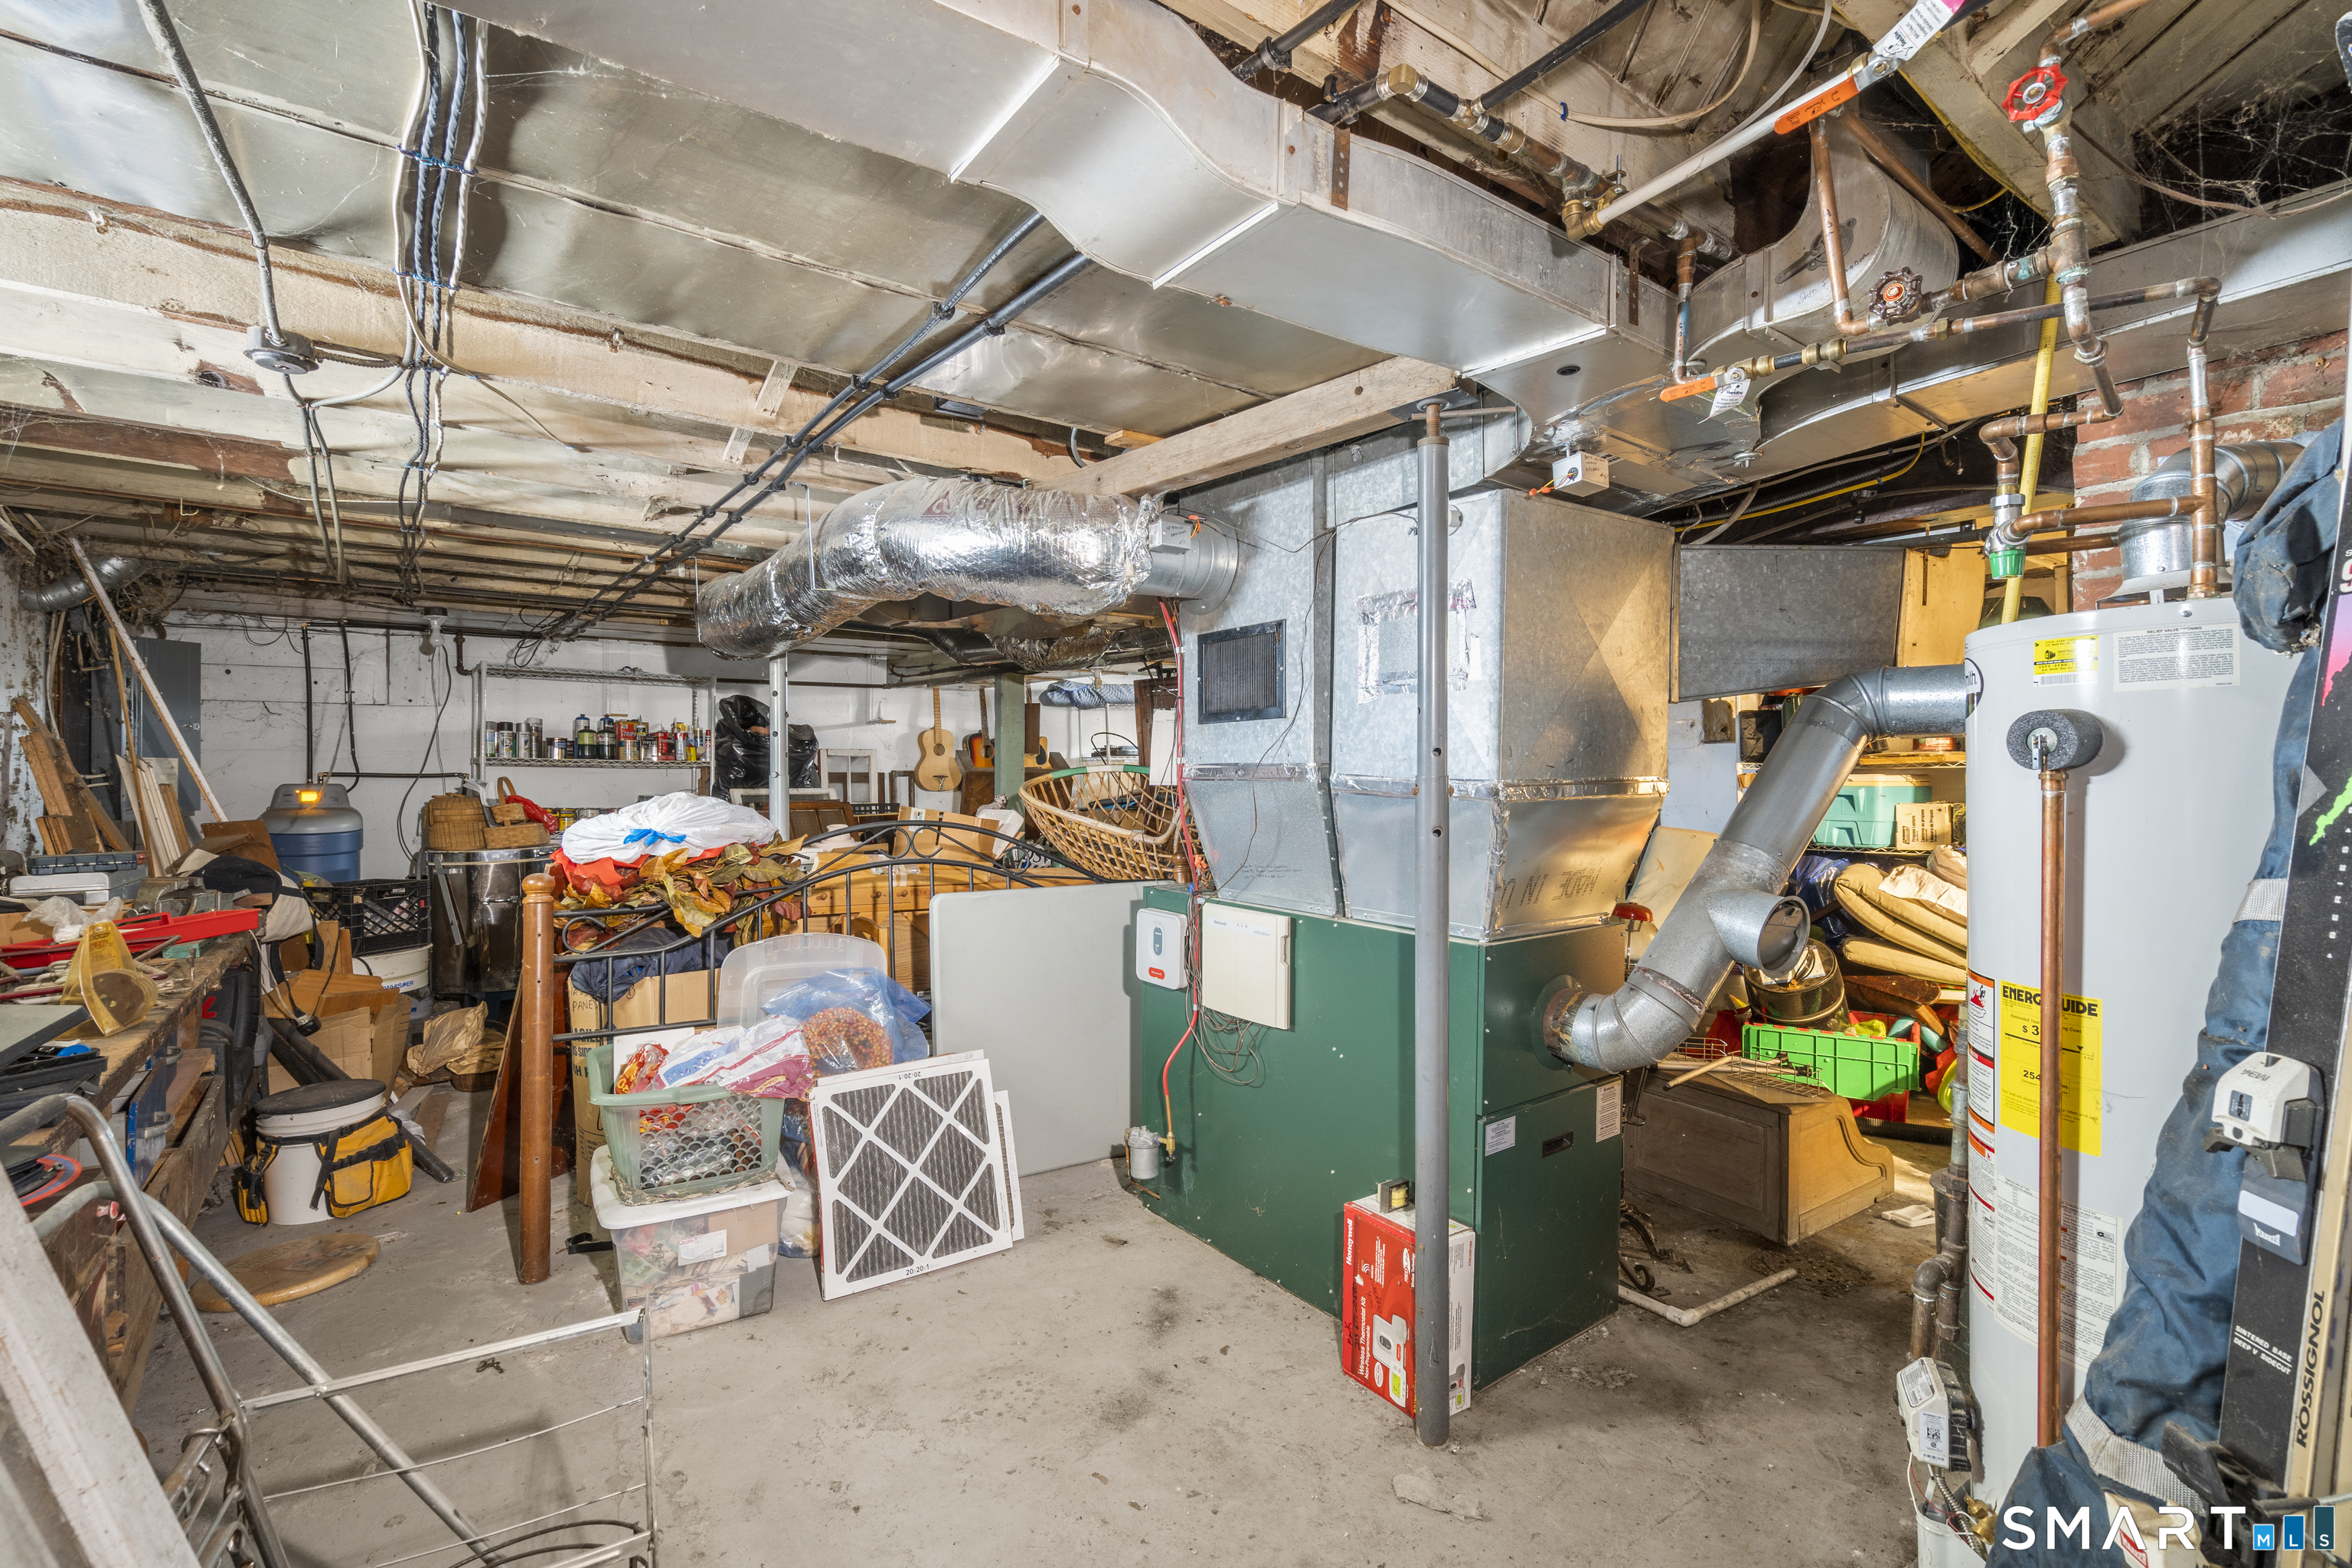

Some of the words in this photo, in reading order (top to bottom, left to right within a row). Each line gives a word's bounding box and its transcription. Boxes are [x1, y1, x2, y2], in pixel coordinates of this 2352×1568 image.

[2233, 1337, 2252, 1351] DEEP
[2260, 1353, 2291, 1375] SIDECUT
[2235, 1325, 2269, 1349] SINTERED
[2272, 1347, 2292, 1362] BASE
[2296, 1291, 2324, 1448] ROSSIGNOL
